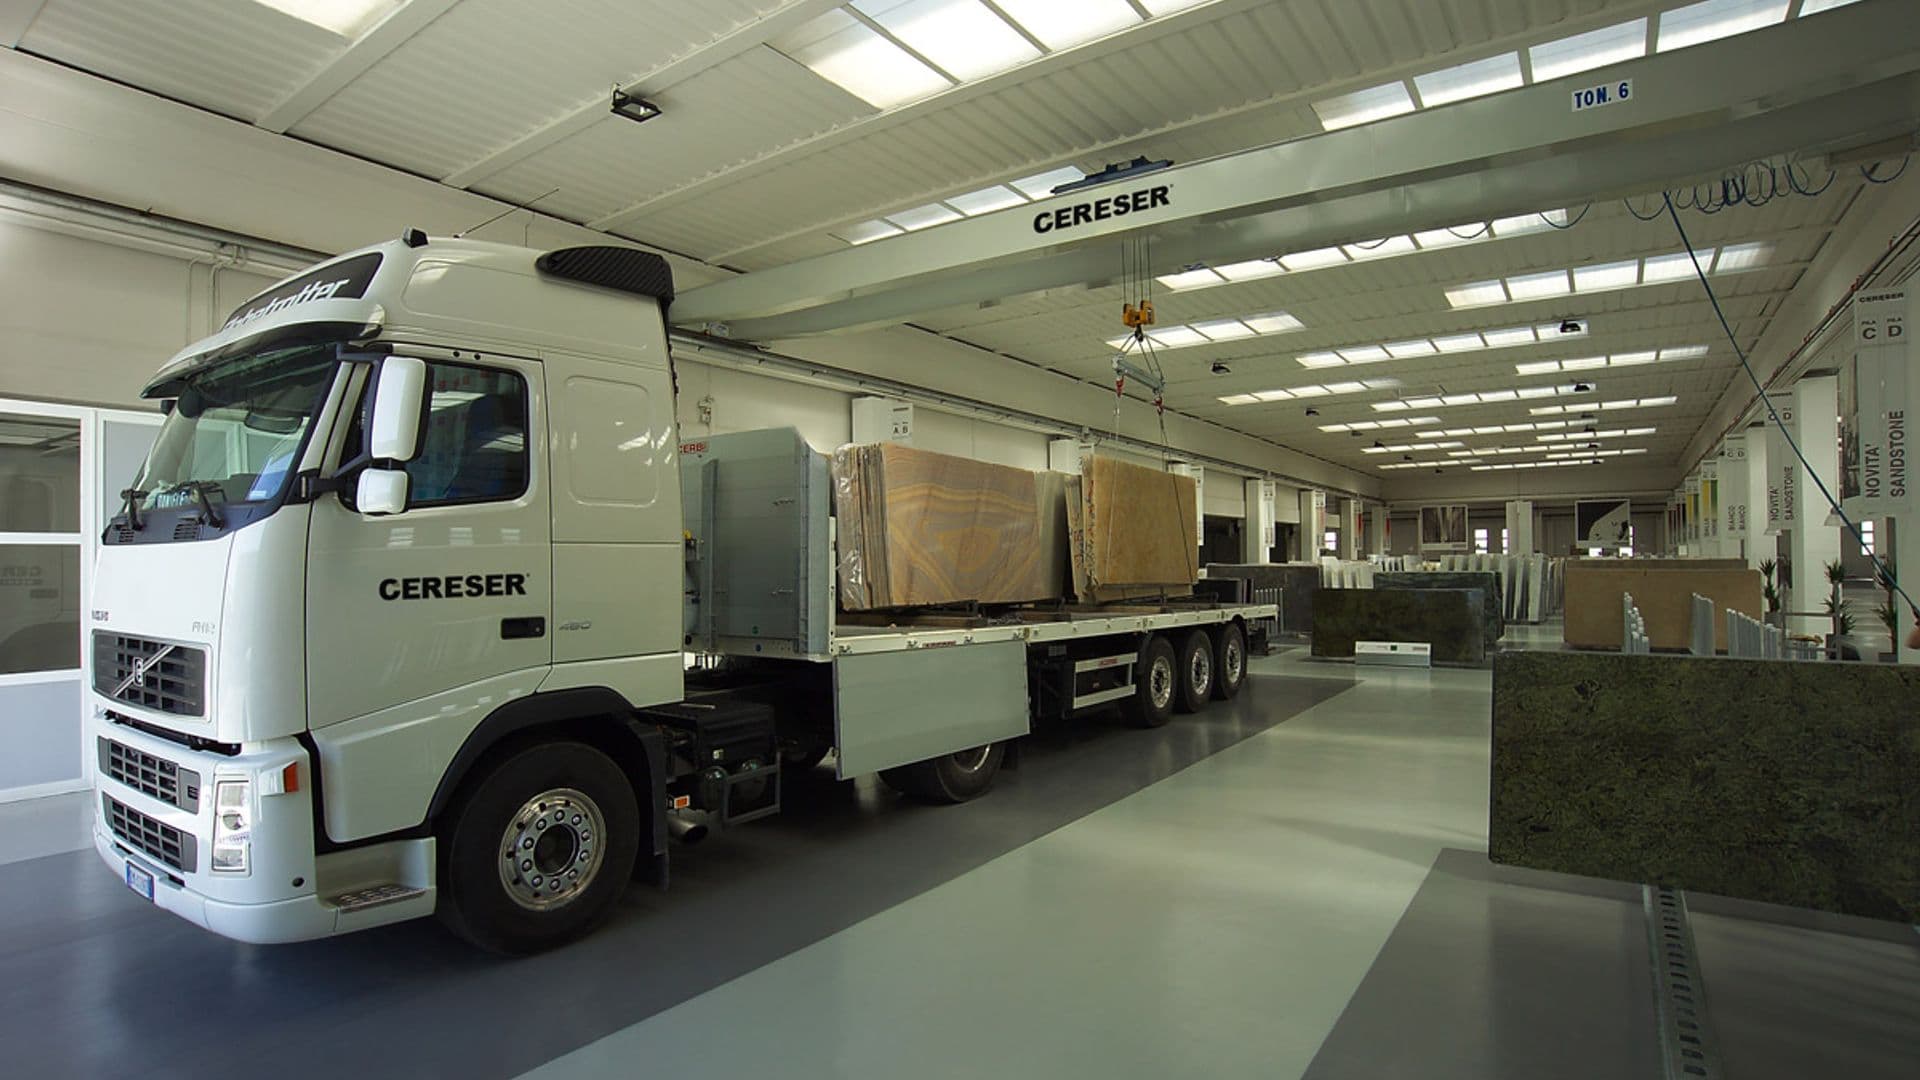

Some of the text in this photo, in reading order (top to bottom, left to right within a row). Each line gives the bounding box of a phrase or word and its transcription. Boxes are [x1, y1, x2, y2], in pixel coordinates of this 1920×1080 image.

[1574, 82, 1629, 109] TON. 6
[1033, 185, 1171, 233] CERESER
[1862, 327, 1877, 340] C
[1887, 325, 1902, 338] D
[1888, 410, 1905, 497] SANDSTONE
[1864, 444, 1880, 498] NOVITA'
[379, 573, 527, 601] CERESER
